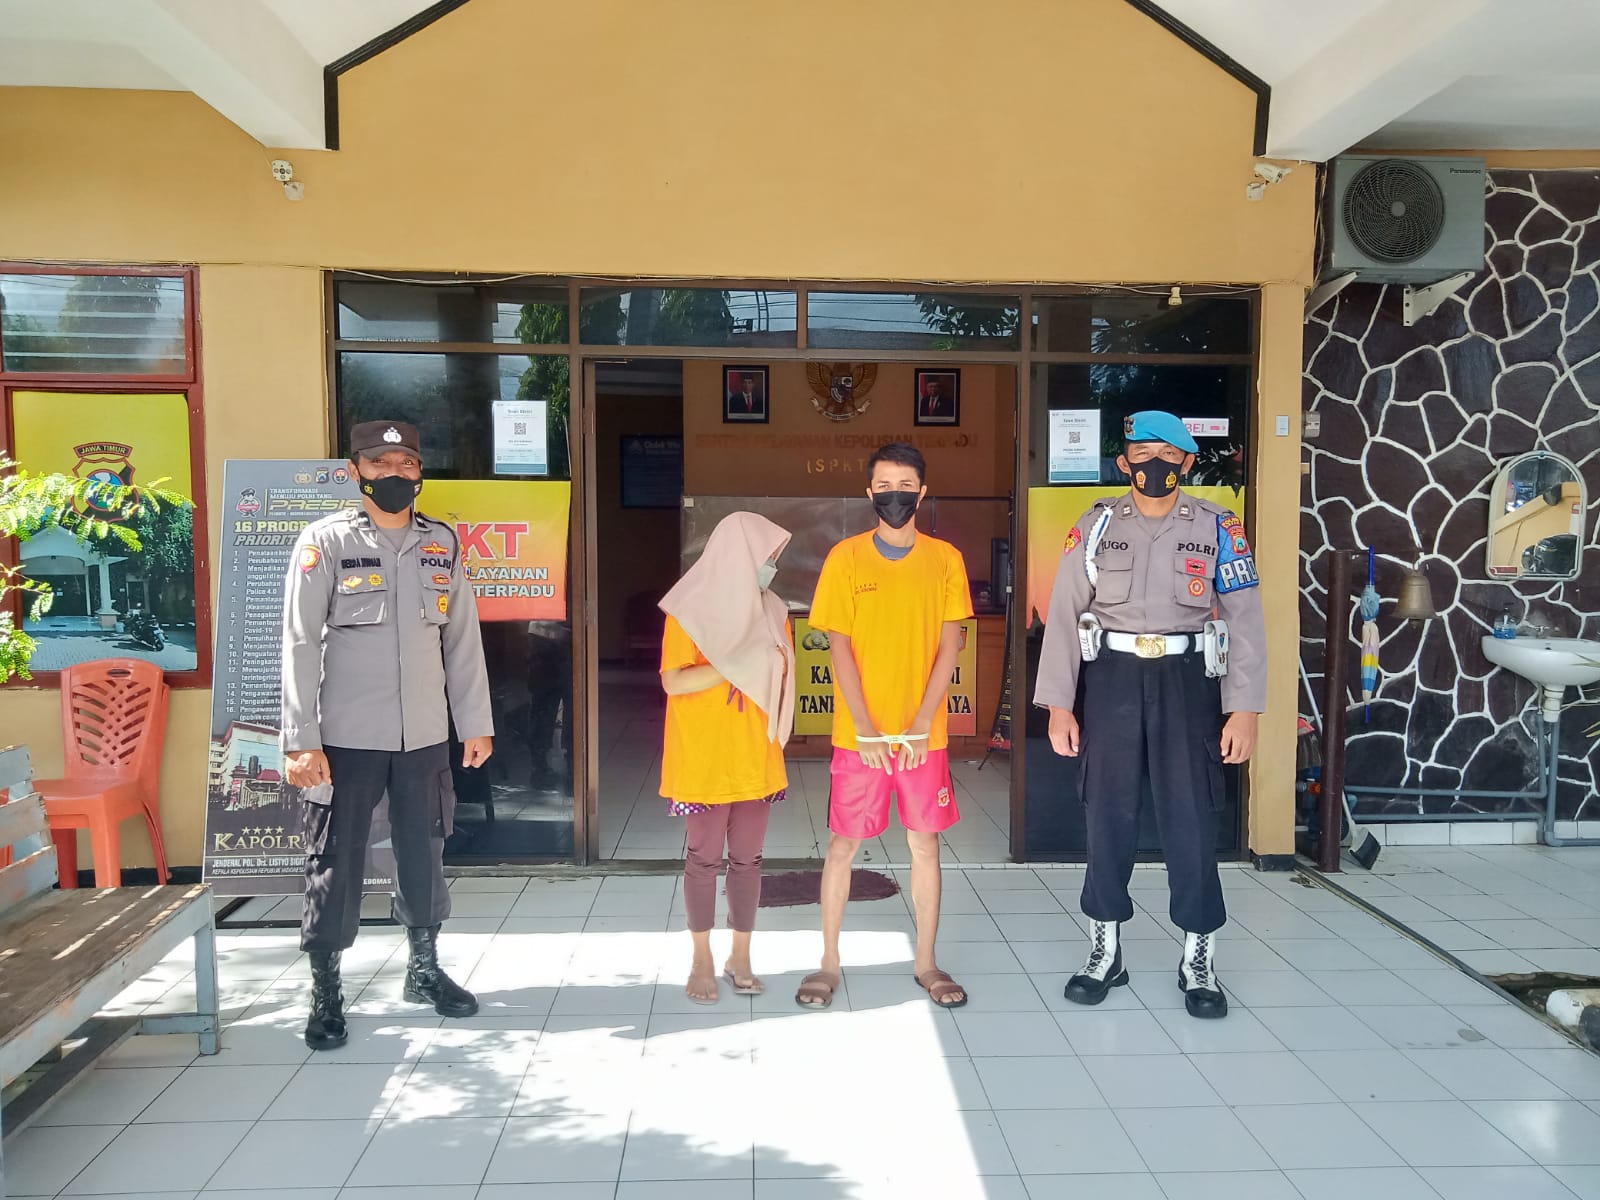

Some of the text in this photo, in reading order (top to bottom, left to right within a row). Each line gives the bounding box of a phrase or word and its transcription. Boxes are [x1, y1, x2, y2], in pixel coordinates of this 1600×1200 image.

[1449, 167, 1481, 175] Panasonic
[234, 521, 252, 533] 16
[1177, 542, 1216, 559] POLRI
[247, 565, 285, 573] Menjadikan
[269, 858, 289, 867] LISTYO
[290, 857, 305, 866] SIGIT
